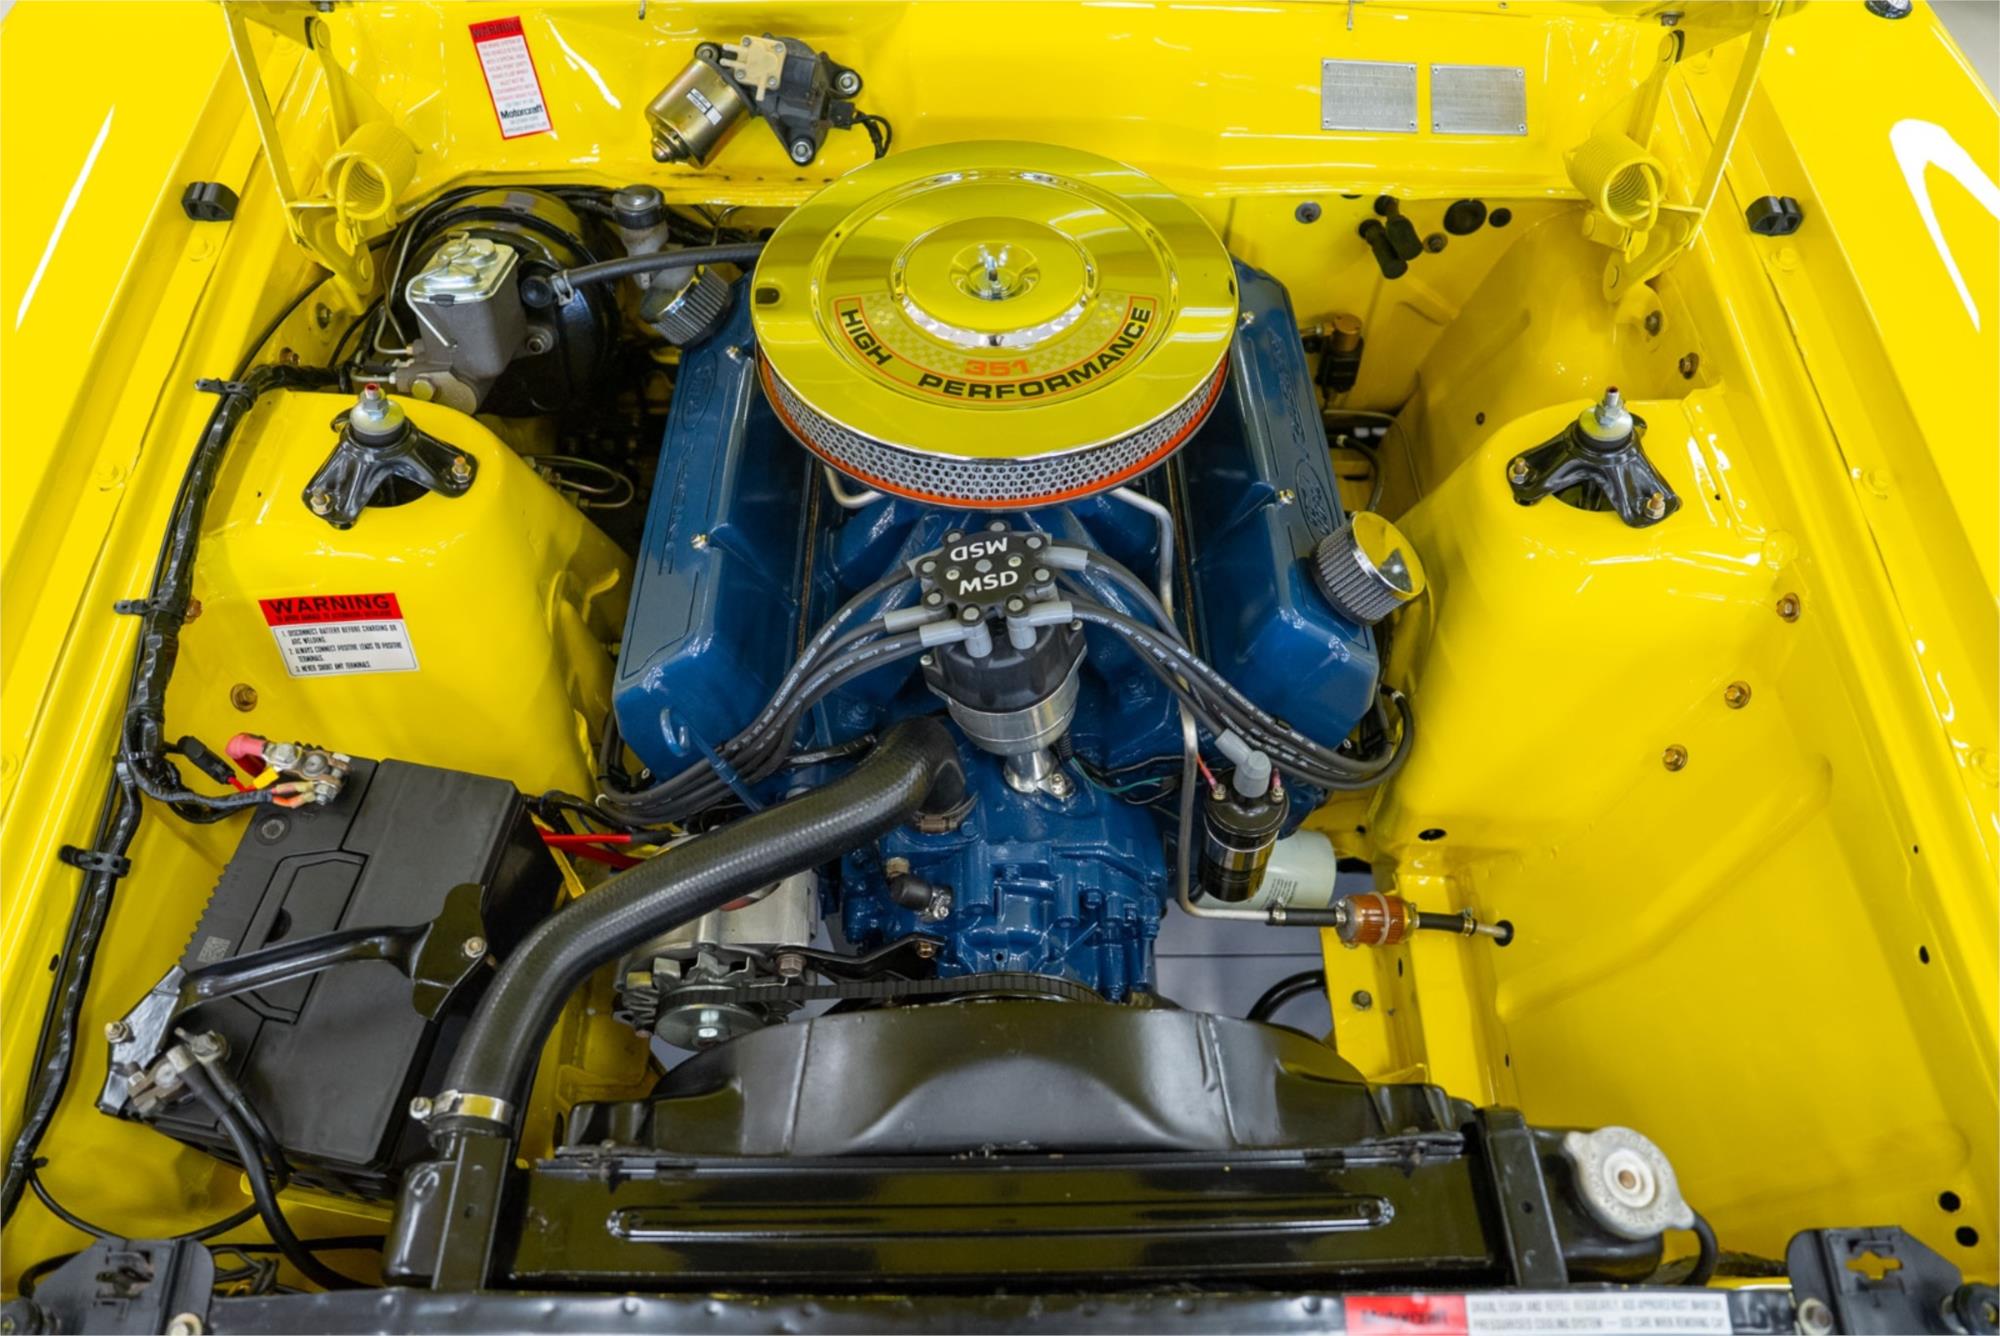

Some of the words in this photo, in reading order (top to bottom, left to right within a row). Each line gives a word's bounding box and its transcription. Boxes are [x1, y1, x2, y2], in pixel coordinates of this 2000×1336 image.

[500, 105, 543, 119] Motorcraft
[840, 308, 892, 366] HIGH
[917, 307, 1151, 399] PERFORMANCE
[964, 359, 1030, 376] 351
[950, 537, 1008, 561] MSD
[959, 570, 1019, 596] MSD
[269, 594, 390, 615] WARNING
[774, 672, 798, 707] CONDUCTOR
